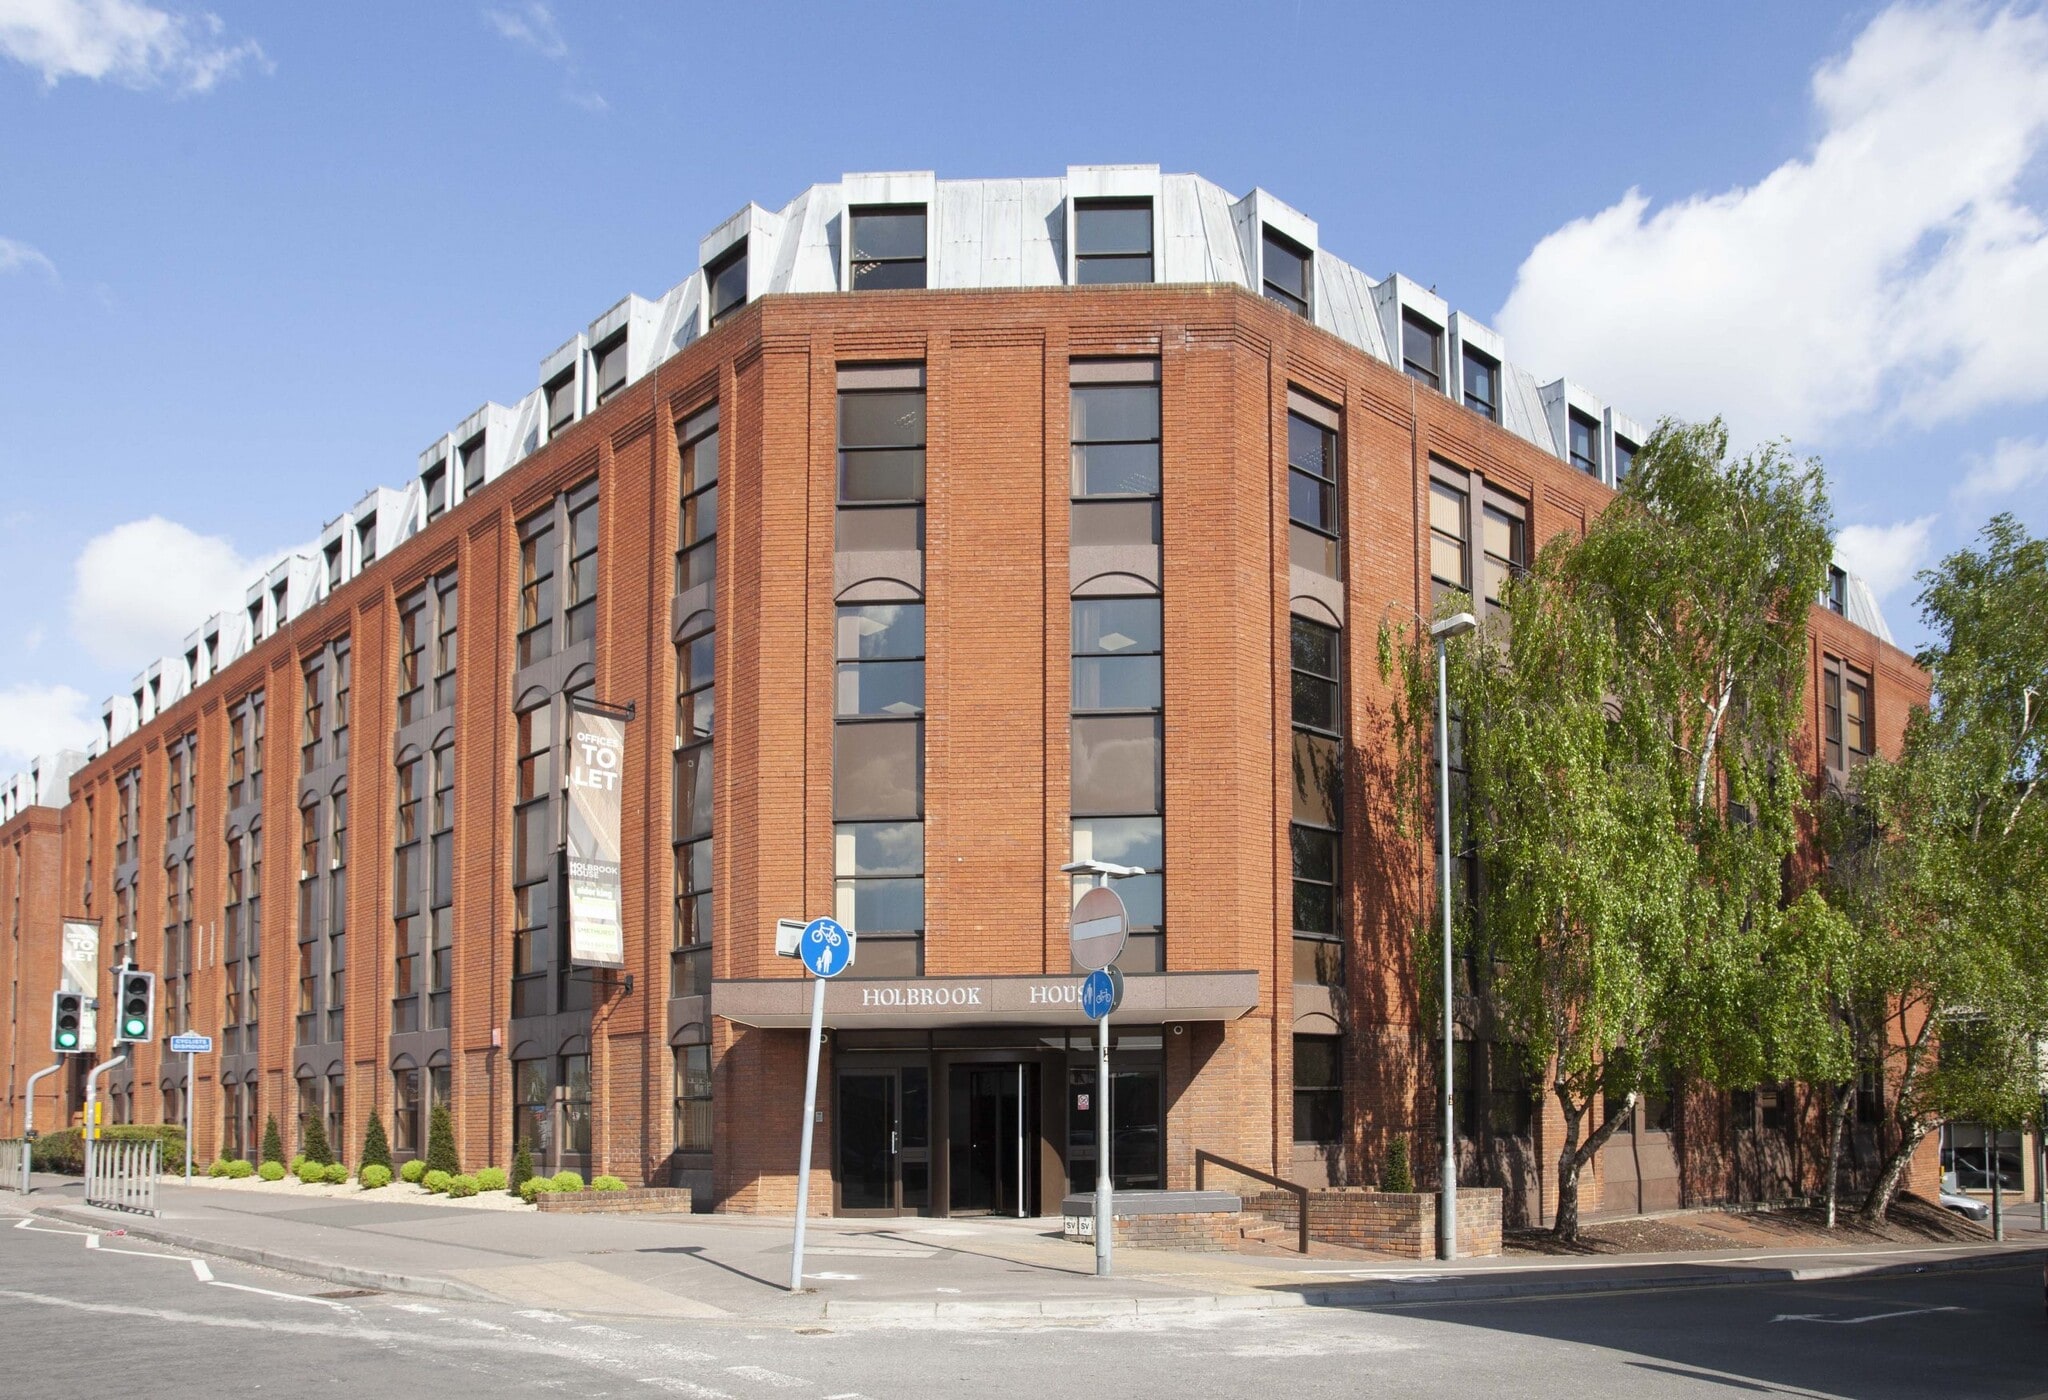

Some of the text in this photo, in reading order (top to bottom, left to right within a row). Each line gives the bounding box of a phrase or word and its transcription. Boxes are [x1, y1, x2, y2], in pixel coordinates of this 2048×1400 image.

[581, 743, 617, 769] TO
[575, 765, 618, 791] LET
[570, 861, 617, 875] HOLBROOK
[570, 869, 599, 878] HOUSE
[70, 938, 95, 951] TO
[66, 950, 95, 962] LET
[862, 987, 982, 1006] HOLBROOK
